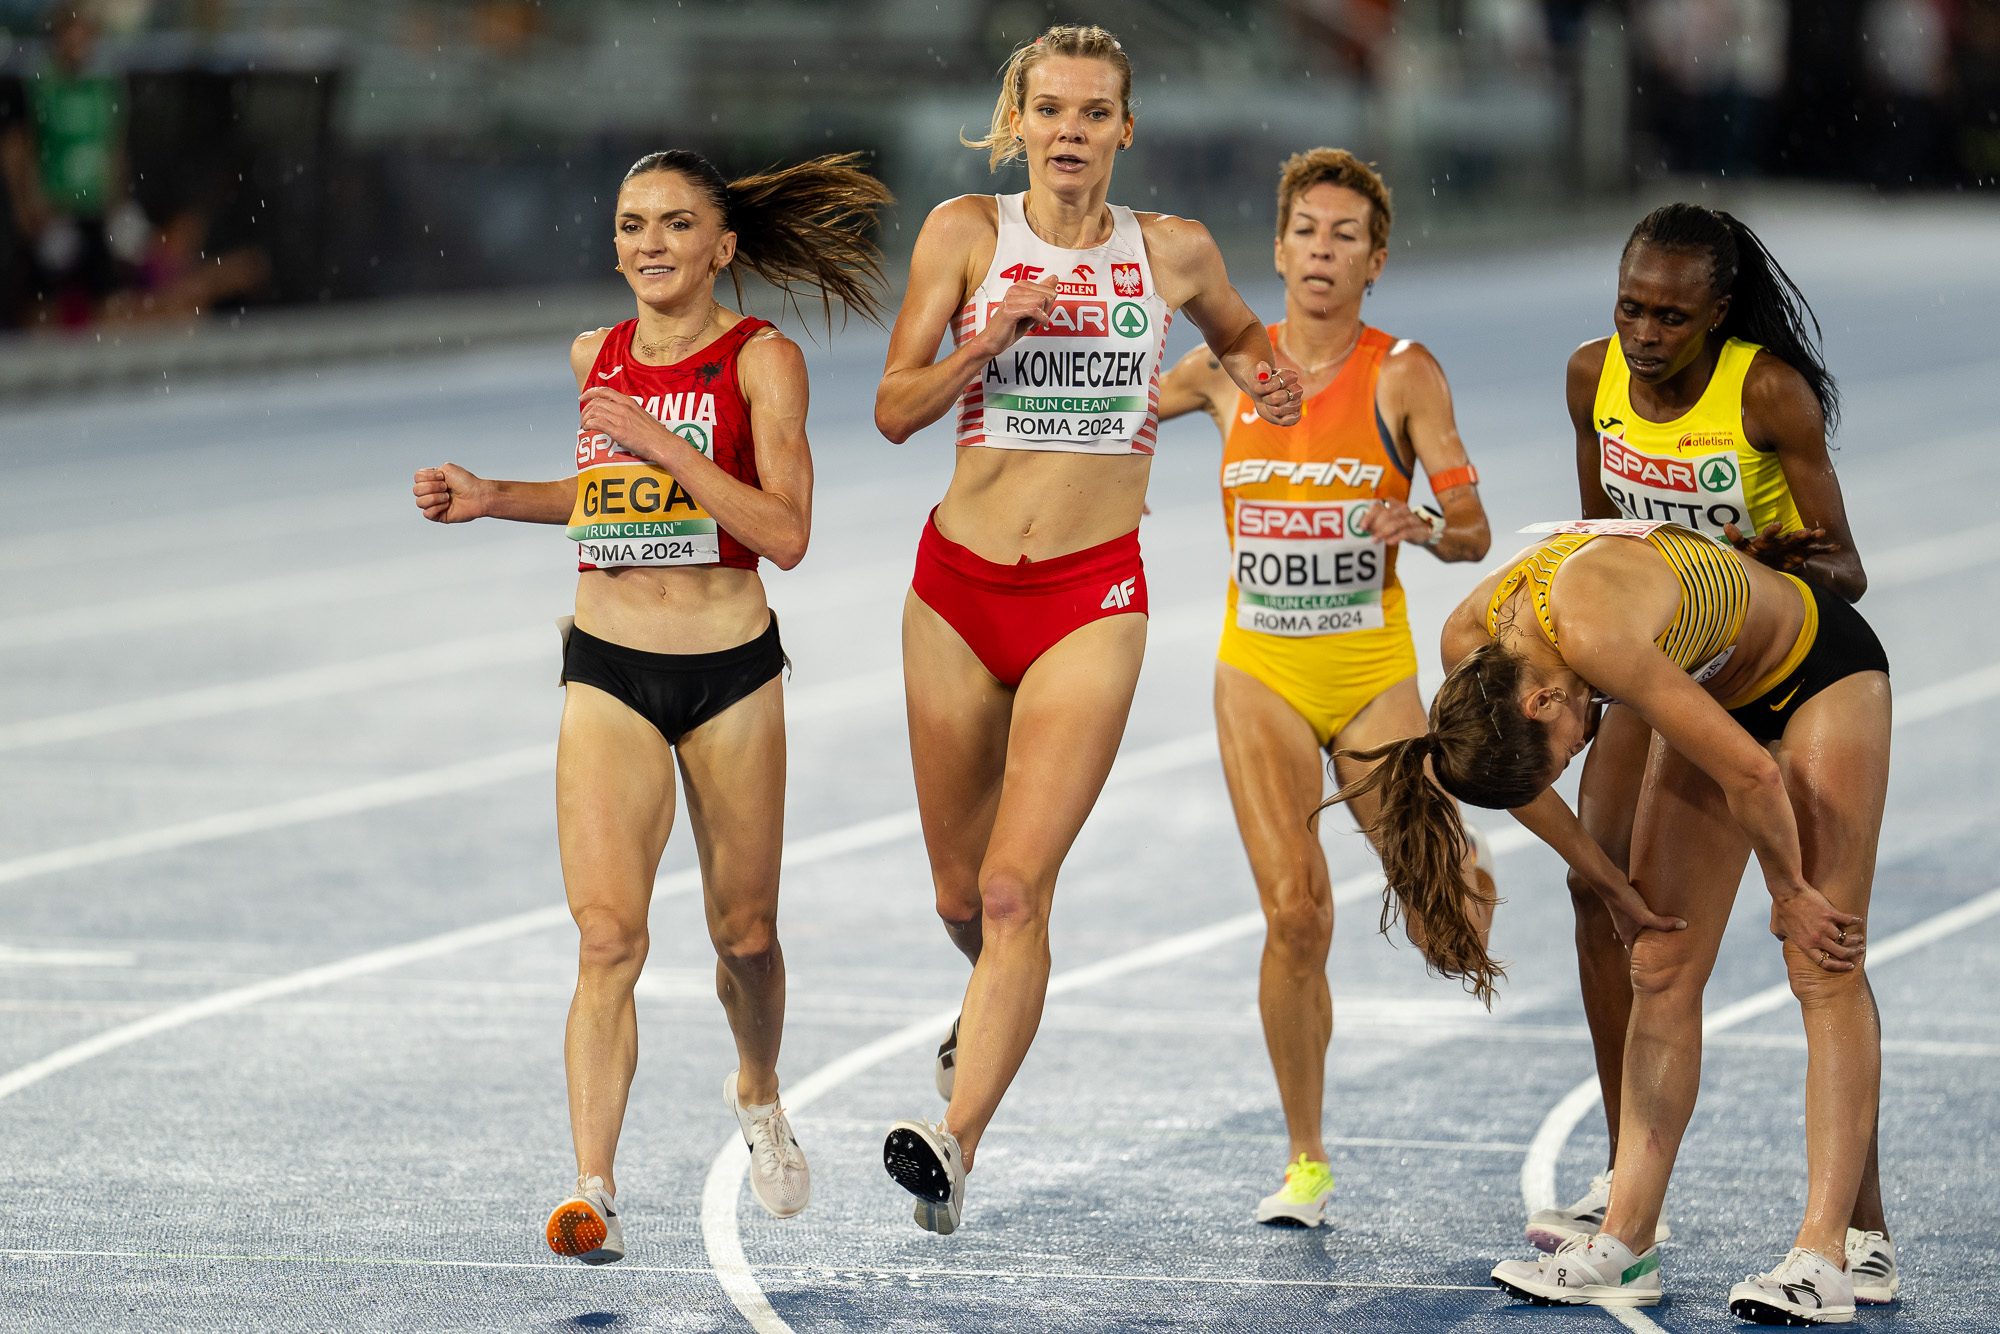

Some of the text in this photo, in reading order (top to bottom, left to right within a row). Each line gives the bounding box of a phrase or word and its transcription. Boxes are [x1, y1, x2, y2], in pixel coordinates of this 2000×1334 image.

[1055, 284, 1094, 295] ORLEN
[986, 351, 1146, 388] A. KONIECZEK
[1018, 397, 1021, 409] I
[1025, 398, 1058, 411] RUN
[1006, 416, 1125, 436] ROMA 2024
[1692, 436, 1734, 447] atletism
[1222, 457, 1384, 490] ESPAÑA
[1605, 443, 1694, 489] SPAR
[583, 477, 698, 518] GEGA
[1605, 483, 1741, 530] RUTTO
[590, 524, 621, 537] RUN
[1240, 508, 1342, 536] SPAR
[590, 541, 695, 562] OMA 2024
[1238, 550, 1377, 586] ROBLES
[1269, 597, 1299, 610] RUN
[1254, 610, 1363, 631] ROMA 2024
